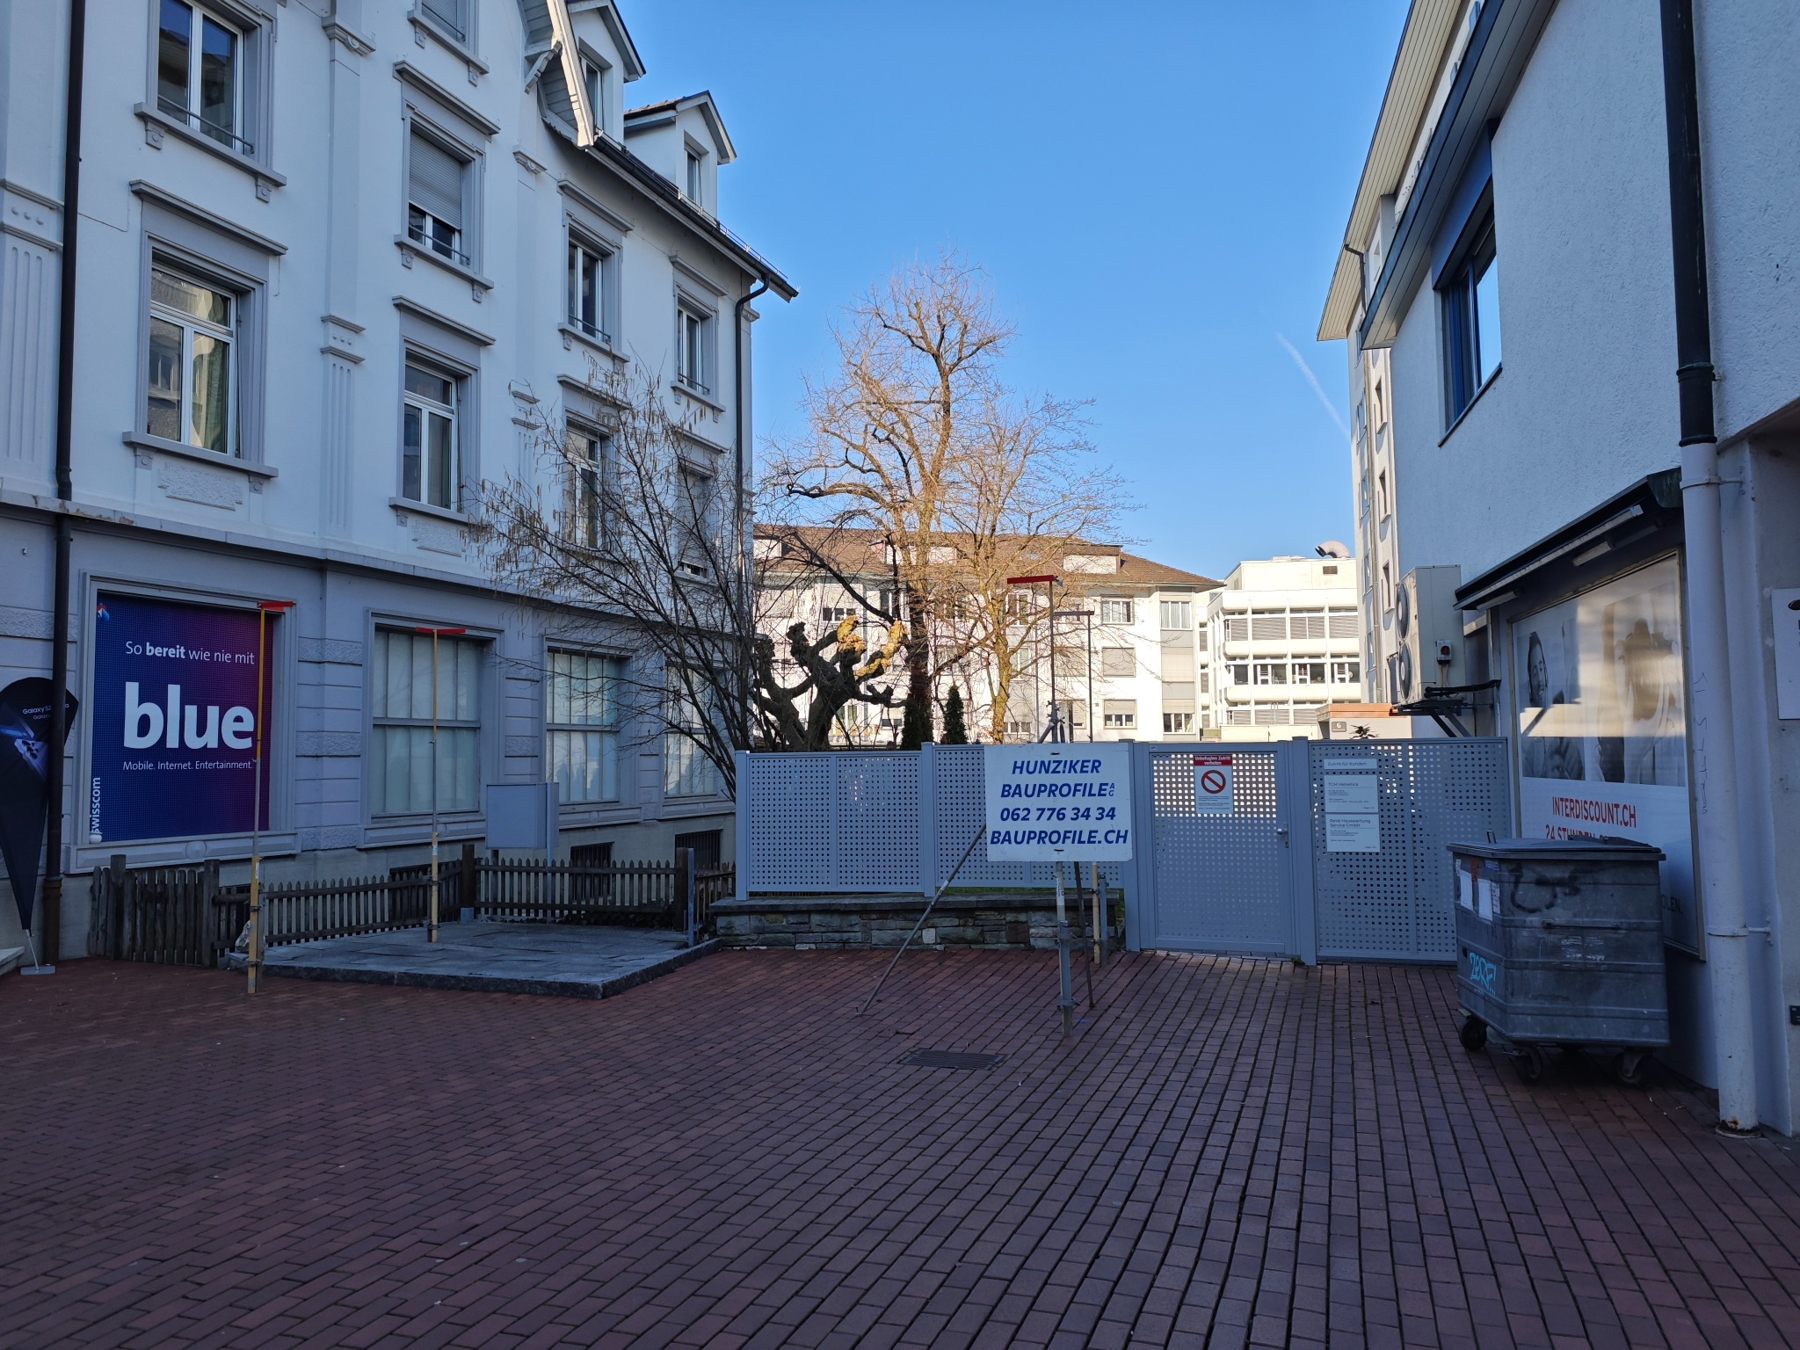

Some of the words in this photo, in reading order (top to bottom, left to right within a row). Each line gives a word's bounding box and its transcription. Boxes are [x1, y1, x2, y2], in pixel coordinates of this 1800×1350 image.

[125, 641, 142, 655] So
[146, 642, 185, 659] bereit
[188, 648, 210, 662] wie
[213, 649, 232, 664] nie
[235, 651, 255, 665] mit
[22, 707, 45, 715] Galaxy
[124, 681, 255, 750] blue
[123, 760, 155, 771] Mobile.
[157, 760, 194, 770] Internet.
[1000, 782, 1109, 798] BAUPROFILE
[1000, 807, 1031, 822] 062
[1035, 807, 1067, 821] 776
[1071, 807, 1091, 821] 34
[1095, 806, 1117, 821] 34
[1552, 796, 1637, 828] INTERDISCOUNT.CH
[990, 829, 1129, 845] BAUPROFILE.CH
[1545, 824, 1555, 840] 24
